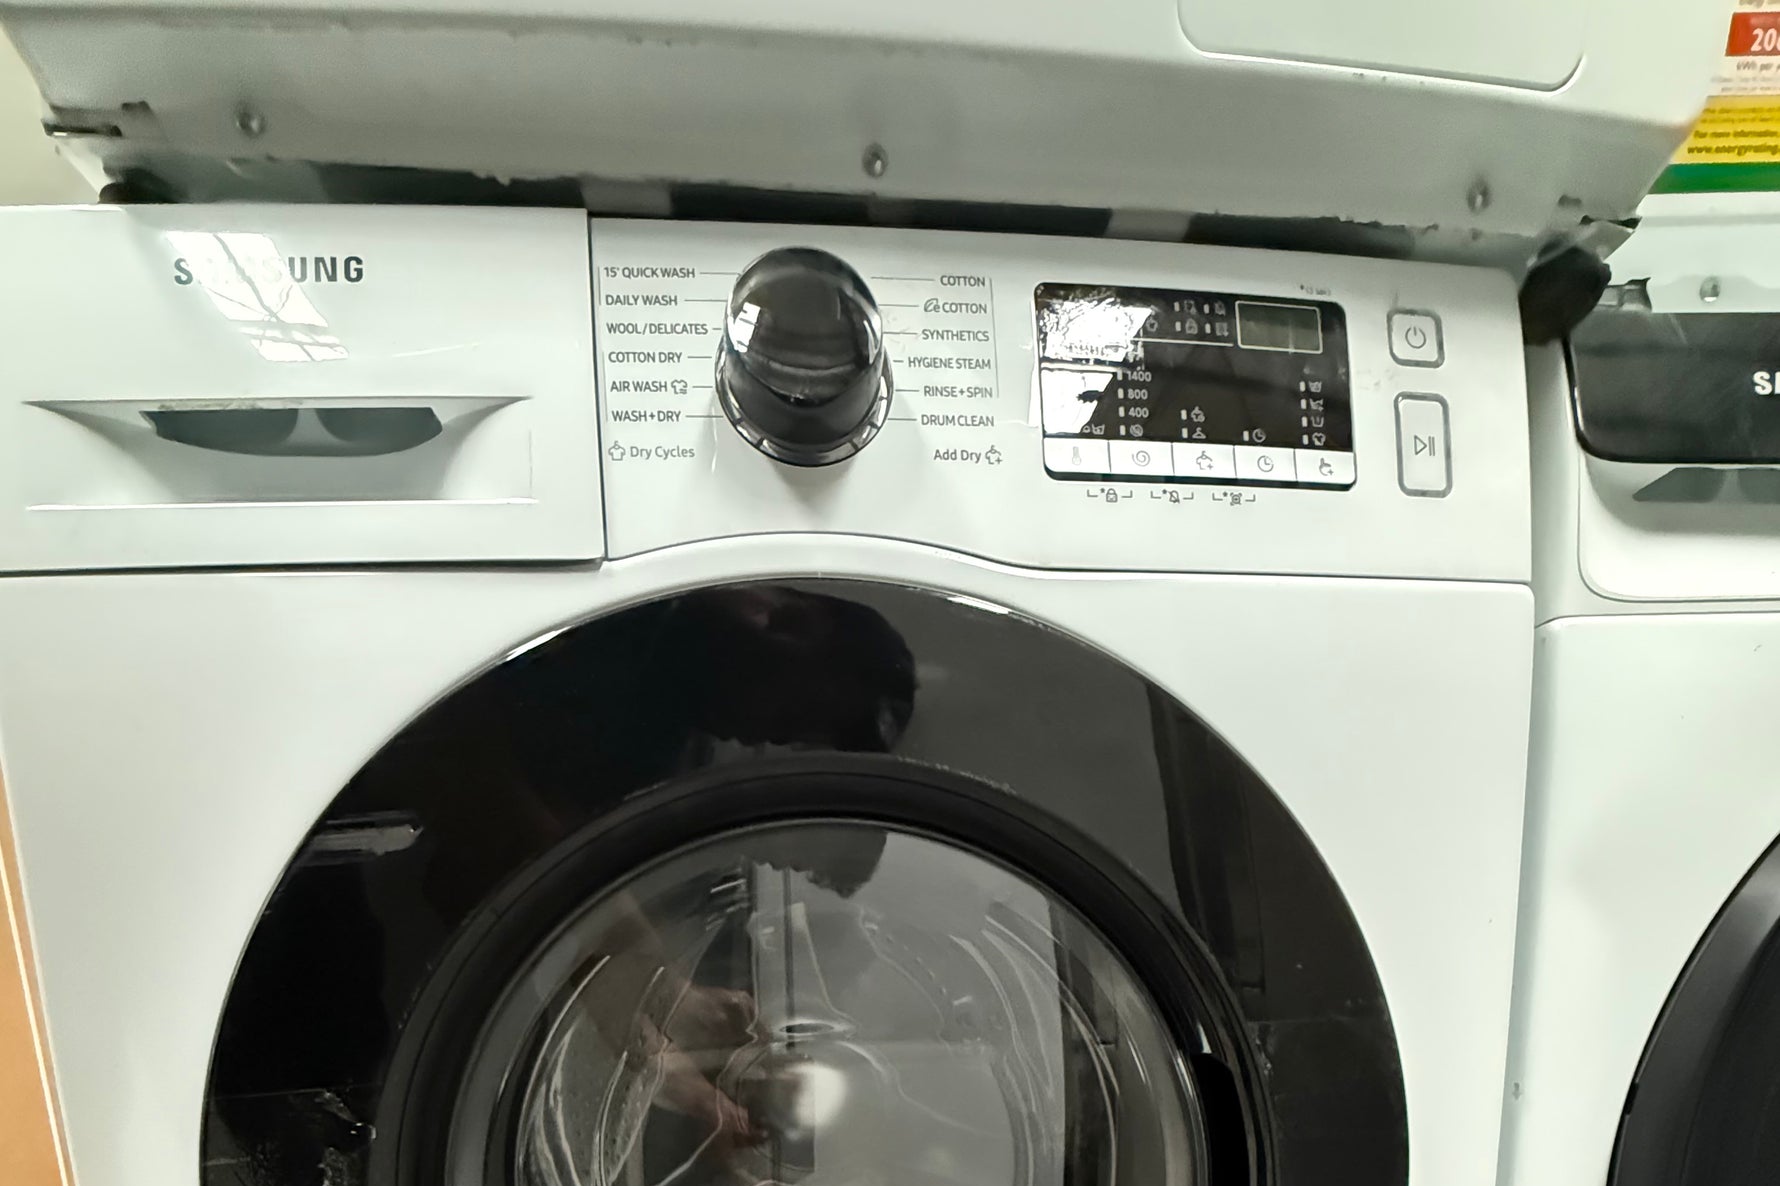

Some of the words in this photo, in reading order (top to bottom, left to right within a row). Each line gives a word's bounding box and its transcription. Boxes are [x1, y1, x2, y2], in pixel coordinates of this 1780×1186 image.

[622, 266, 659, 280] QUICK
[660, 267, 696, 279] WASH
[940, 275, 986, 287] COTTON
[605, 294, 640, 306] DAILY
[642, 295, 678, 306] WASH
[921, 328, 990, 342] SYNTHETICS
[608, 351, 656, 363] COTTON
[658, 351, 683, 363] DRY
[907, 356, 954, 369] HYGIENE
[956, 358, 991, 370] STEAM
[1127, 371, 1152, 382] 1400
[610, 380, 631, 393] AIR
[632, 380, 668, 393] WASH
[1128, 389, 1148, 399] 800
[1128, 407, 1150, 418] 400
[921, 414, 956, 426] DRUM
[957, 415, 995, 427] CLEAN
[630, 446, 652, 460] Dry
[655, 445, 696, 460] Cycles
[933, 448, 958, 461] Add
[960, 449, 982, 464] Dry
